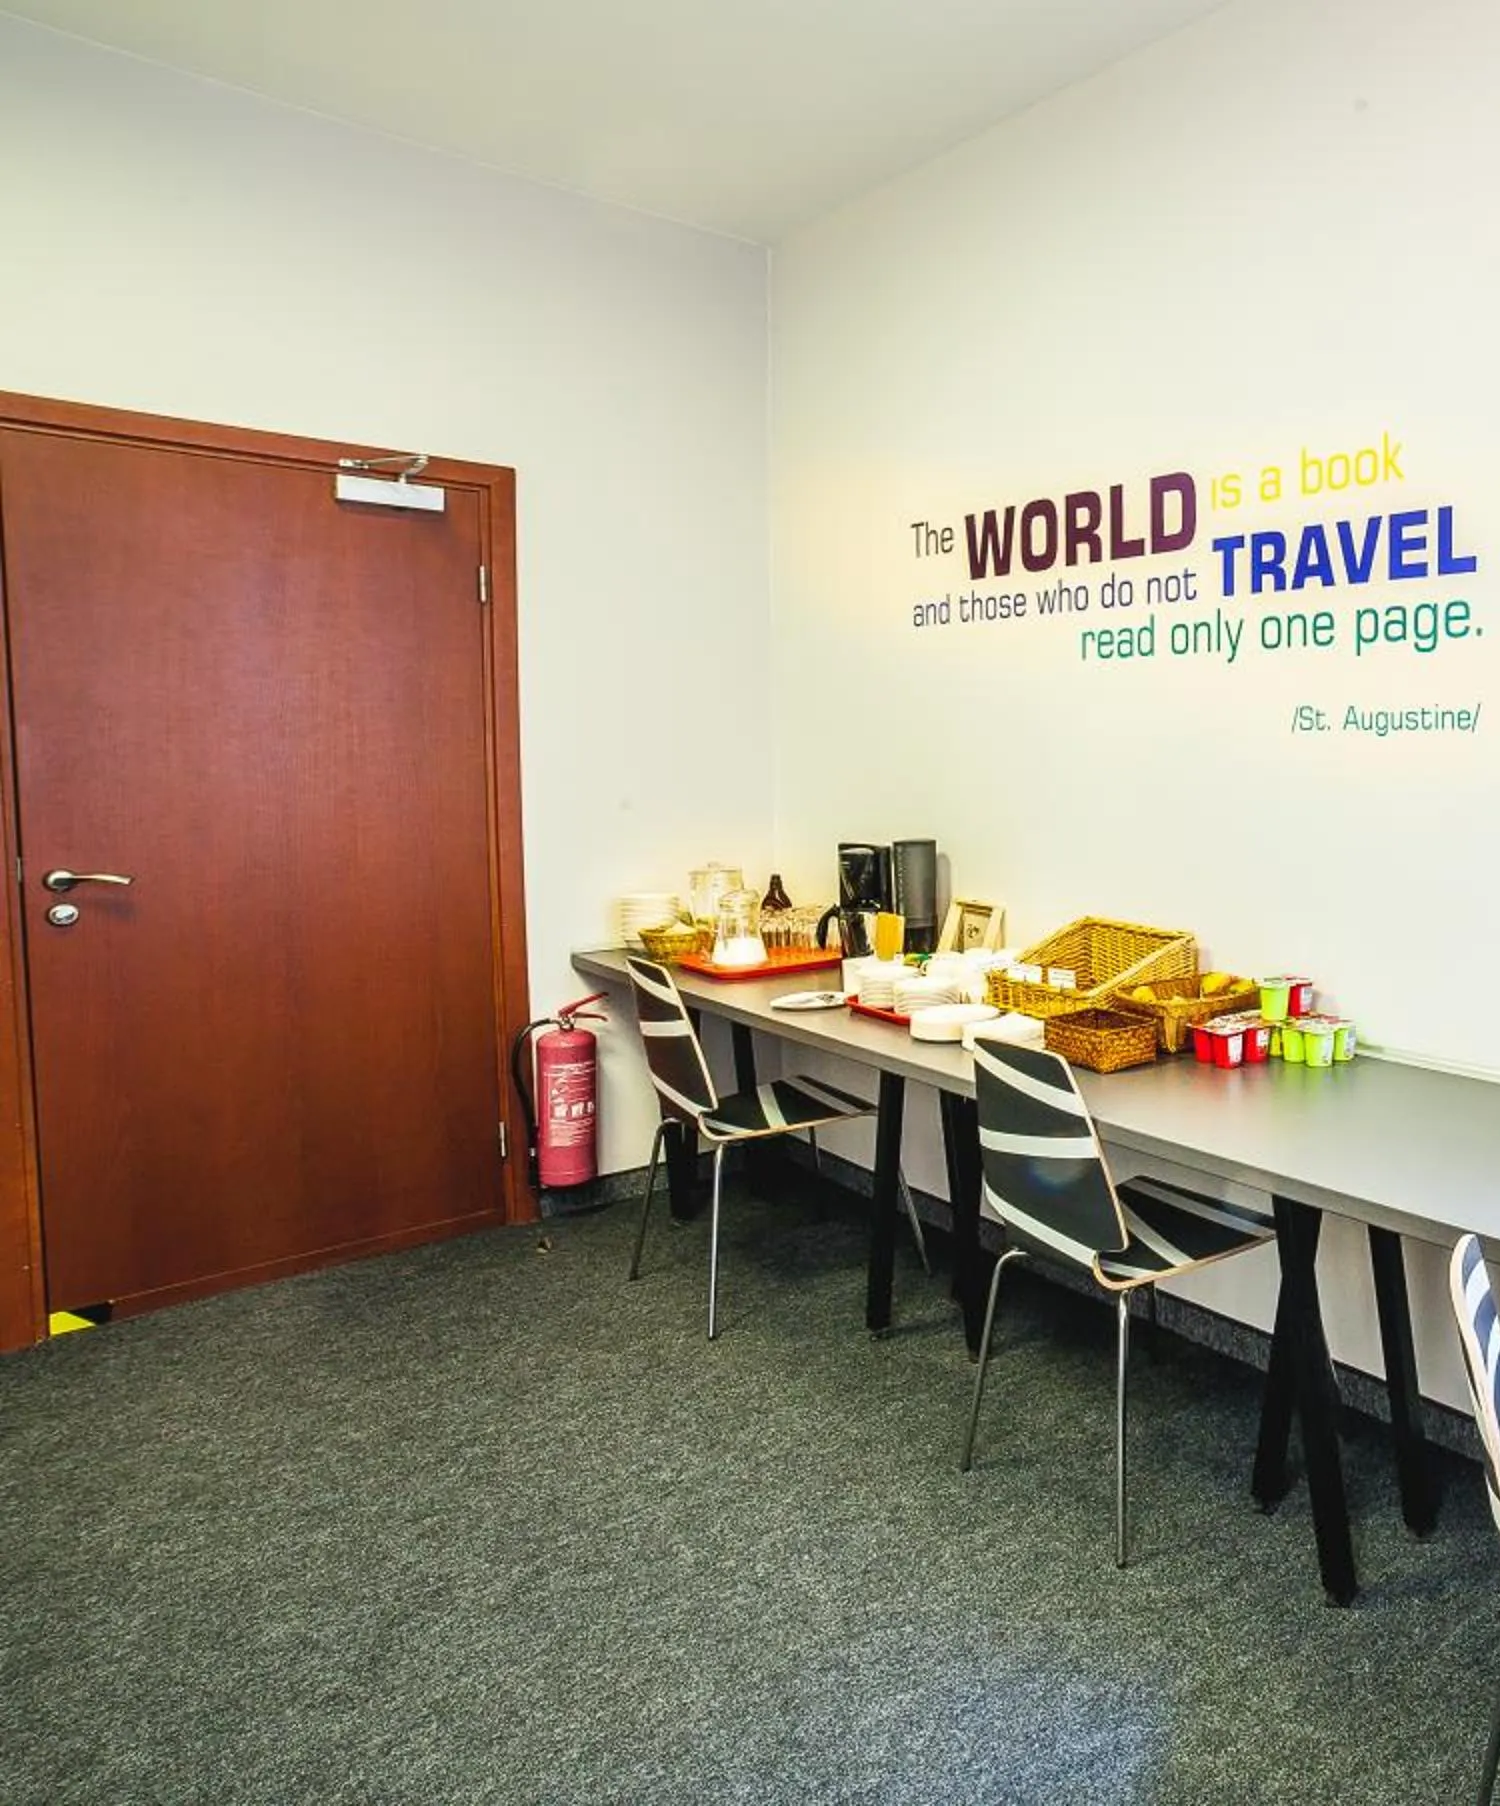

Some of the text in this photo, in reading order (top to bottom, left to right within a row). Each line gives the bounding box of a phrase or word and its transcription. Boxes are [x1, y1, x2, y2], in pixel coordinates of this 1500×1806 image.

[910, 430, 1405, 581] The WORLD is a book
[912, 505, 1478, 628] and those who do not TRAVEL
[1081, 599, 1485, 664] read only one page.
[1291, 703, 1482, 737] /St. Augustine/
